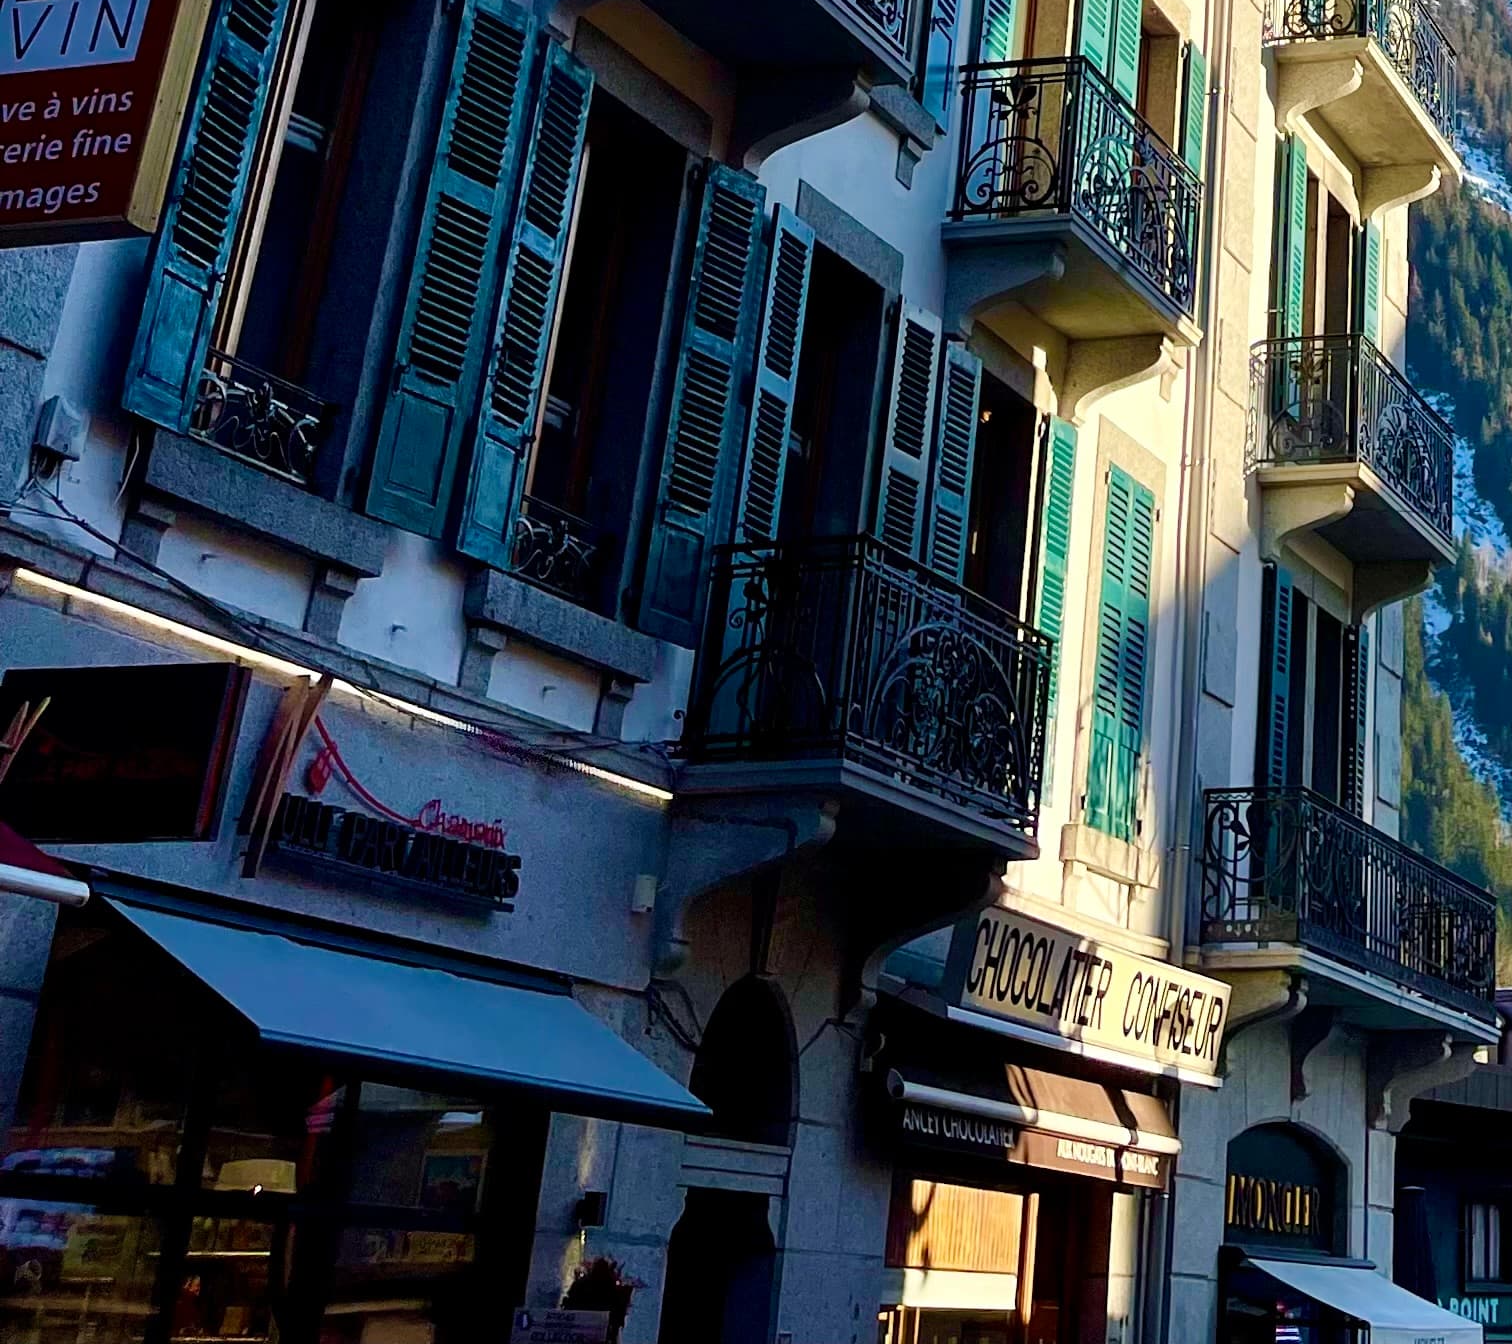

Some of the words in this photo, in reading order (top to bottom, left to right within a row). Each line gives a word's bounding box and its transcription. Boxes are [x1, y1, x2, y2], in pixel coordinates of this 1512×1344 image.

[43, 91, 61, 120] à
[72, 88, 134, 116] vins
[0, 133, 63, 164] erie
[71, 129, 132, 158] fine
[966, 917, 1113, 1030] CHOCOLATIER
[1122, 970, 1224, 1061] CONFISEUR
[1227, 1174, 1320, 1235] MONCLER
[1450, 1297, 1499, 1323] POINT
